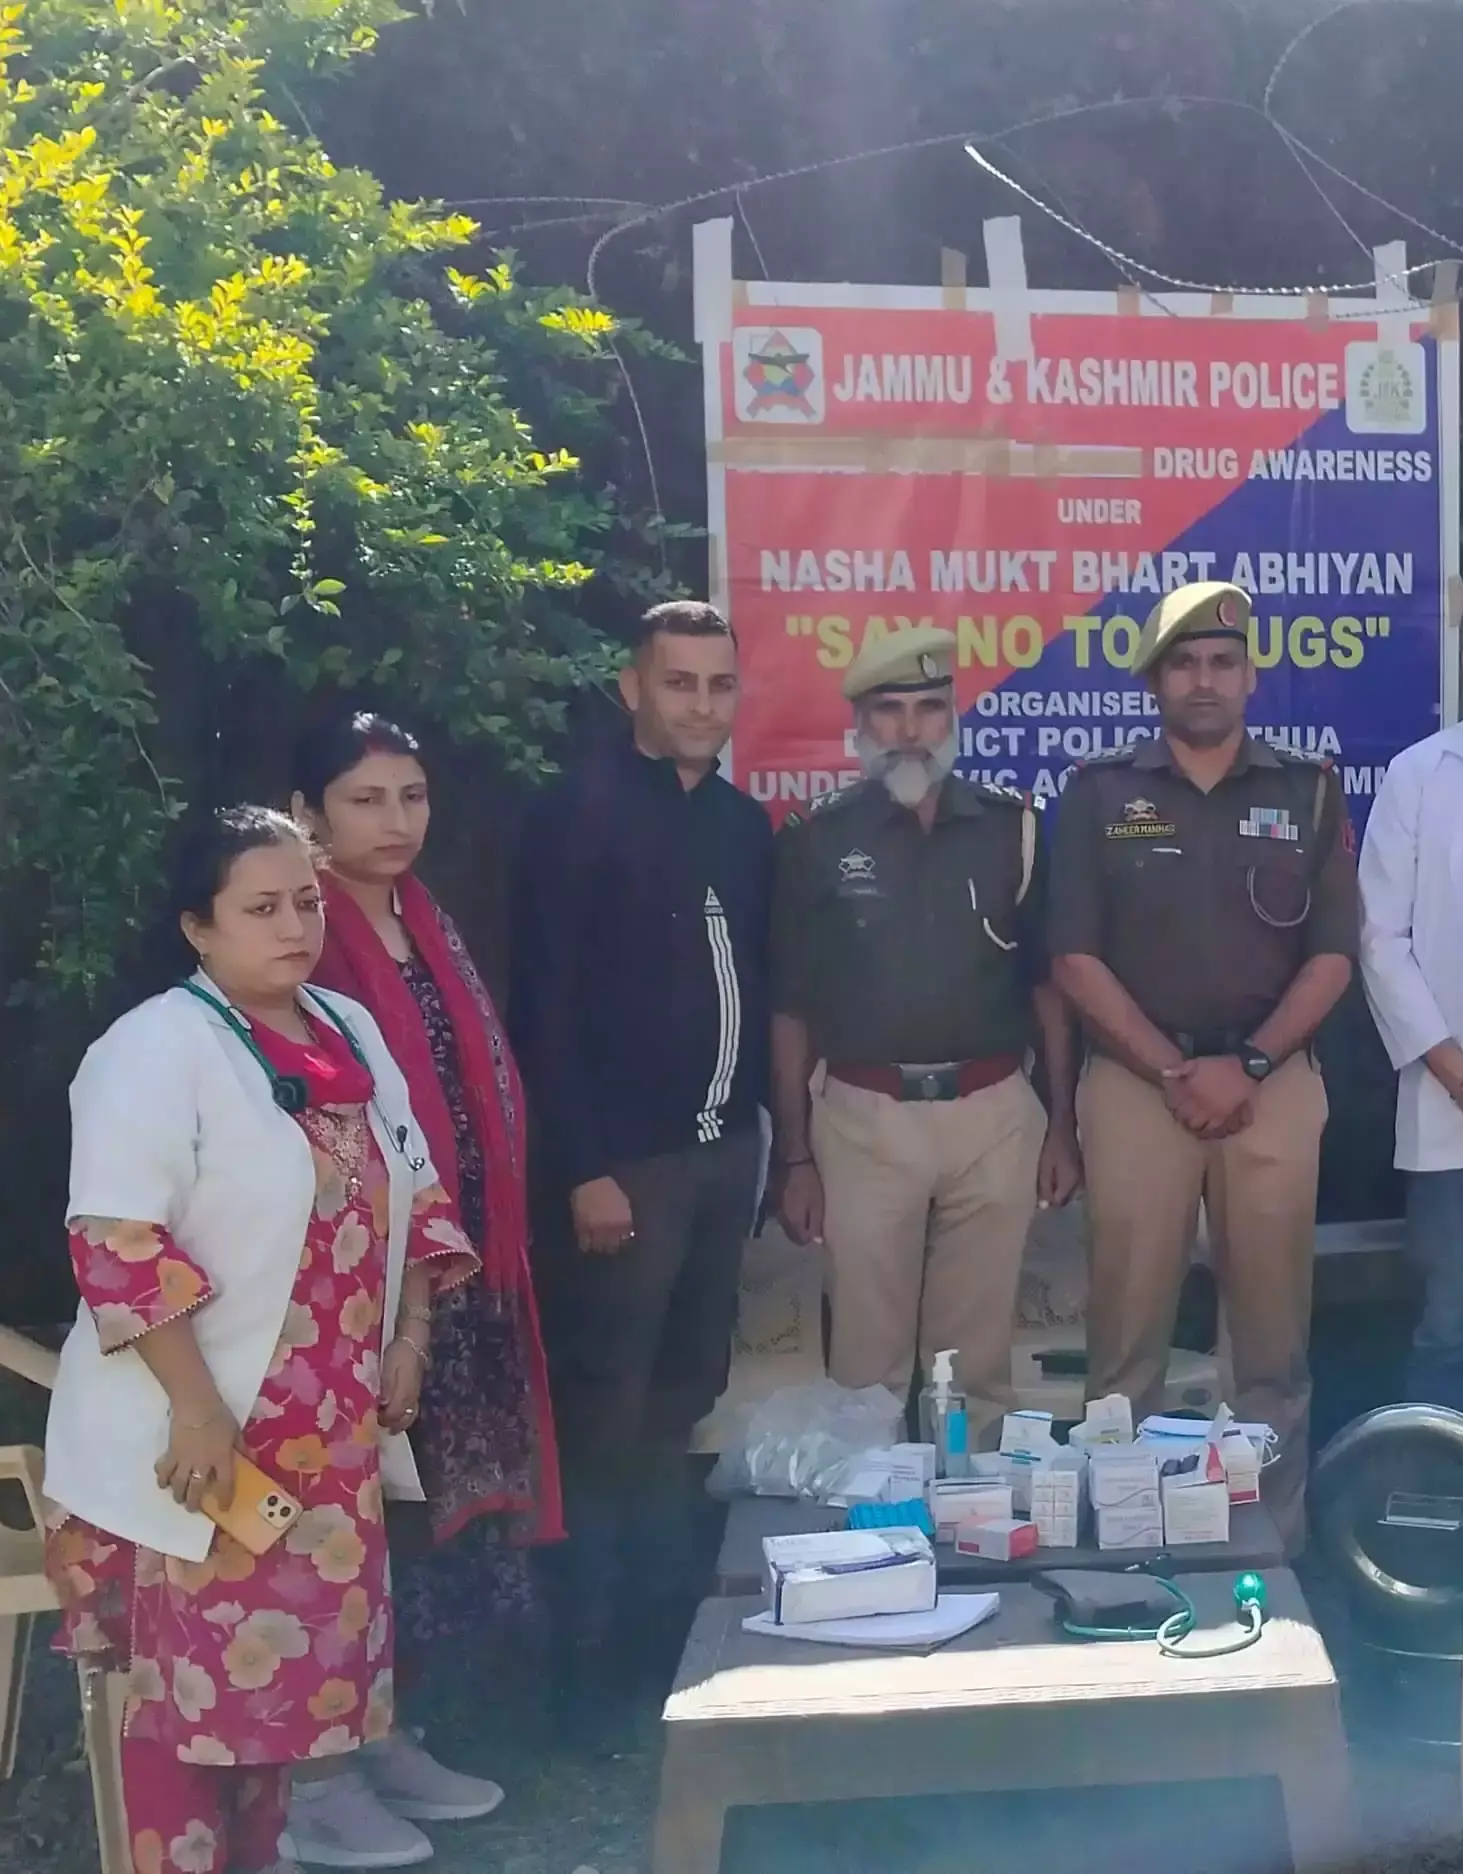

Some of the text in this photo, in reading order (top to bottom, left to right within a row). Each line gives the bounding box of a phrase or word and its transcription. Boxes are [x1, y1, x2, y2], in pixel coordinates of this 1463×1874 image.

[833, 353, 1340, 410] JAMMU & KASHMIR POLICE
[1153, 447, 1433, 482] DRUG AWARENESS
[1057, 498, 1142, 526] UNDER
[760, 549, 1413, 596] NASHA MUKT BHART ABHIYAN
[957, 615, 1044, 669] NO
[1062, 615, 1141, 669] TO
[975, 690, 1161, 717] ORGANISED
